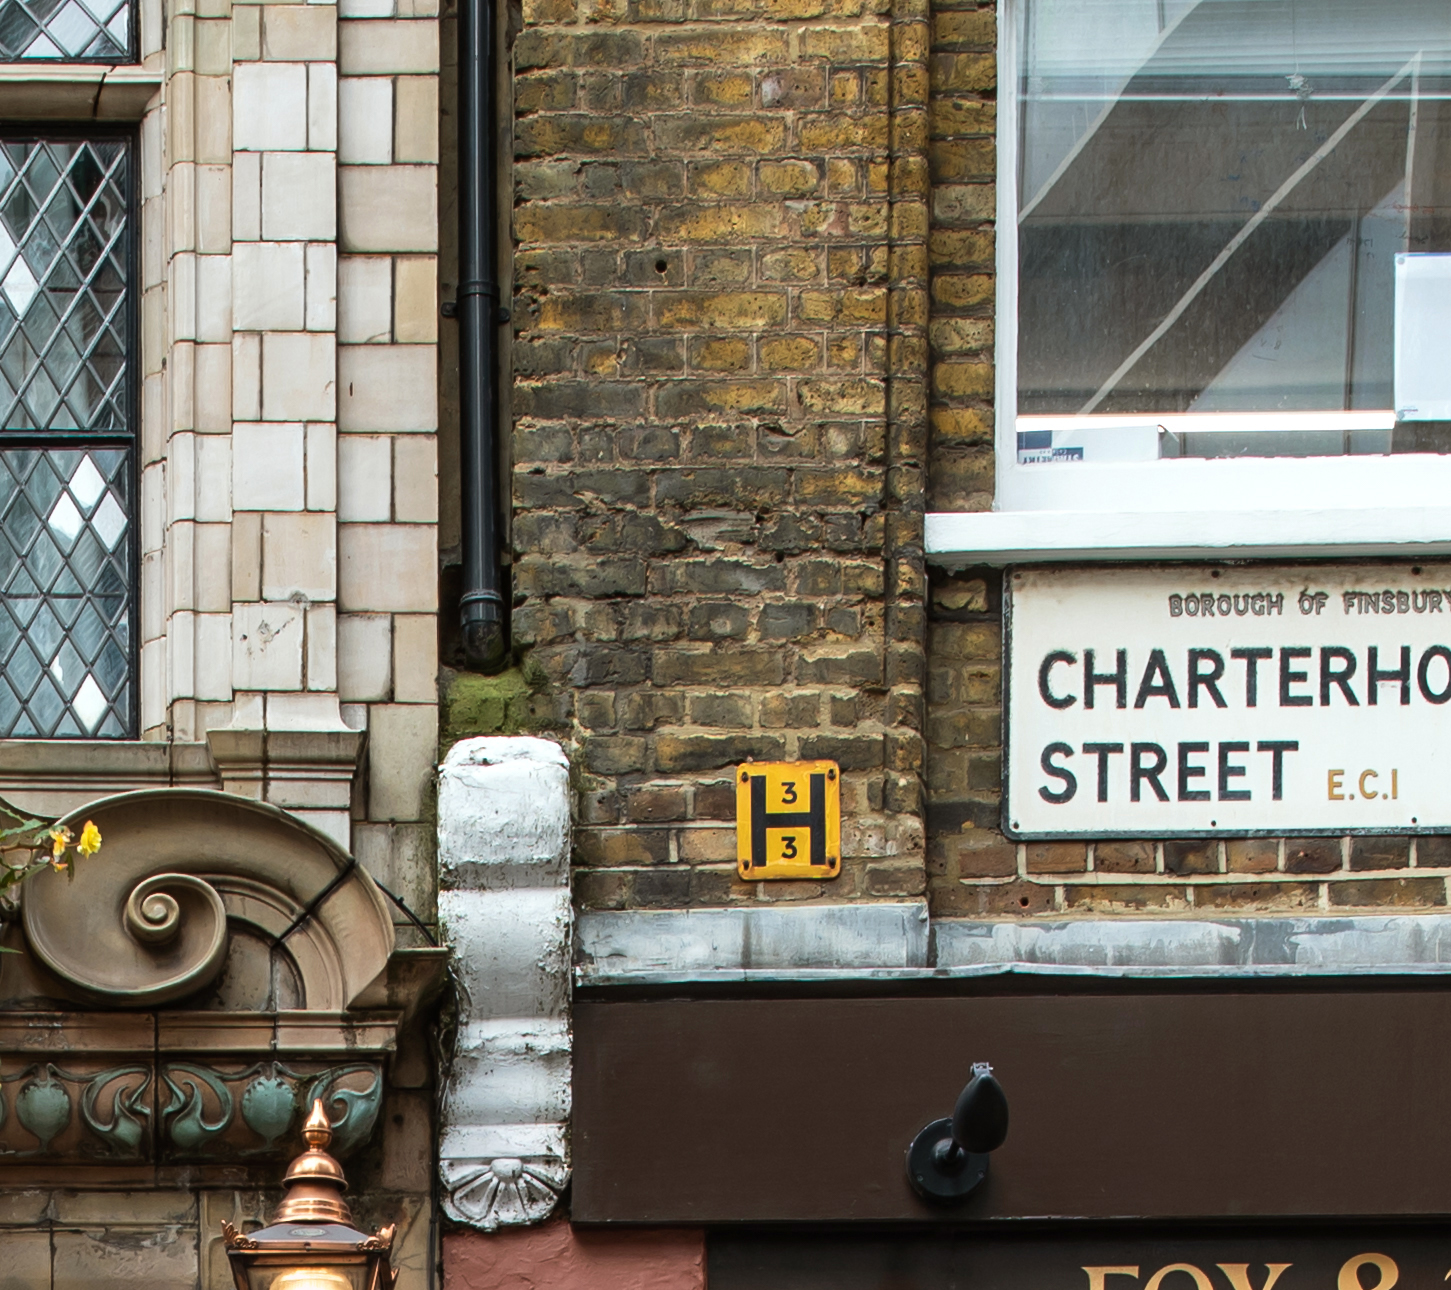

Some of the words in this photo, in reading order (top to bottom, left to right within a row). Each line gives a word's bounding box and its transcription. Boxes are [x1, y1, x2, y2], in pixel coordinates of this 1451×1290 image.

[1168, 593, 1284, 618] BOROUGH
[1299, 591, 1327, 617] OF
[1037, 740, 1300, 804] STREET
[781, 782, 798, 804] 3
[750, 773, 826, 867] H
[780, 836, 798, 859] 3
